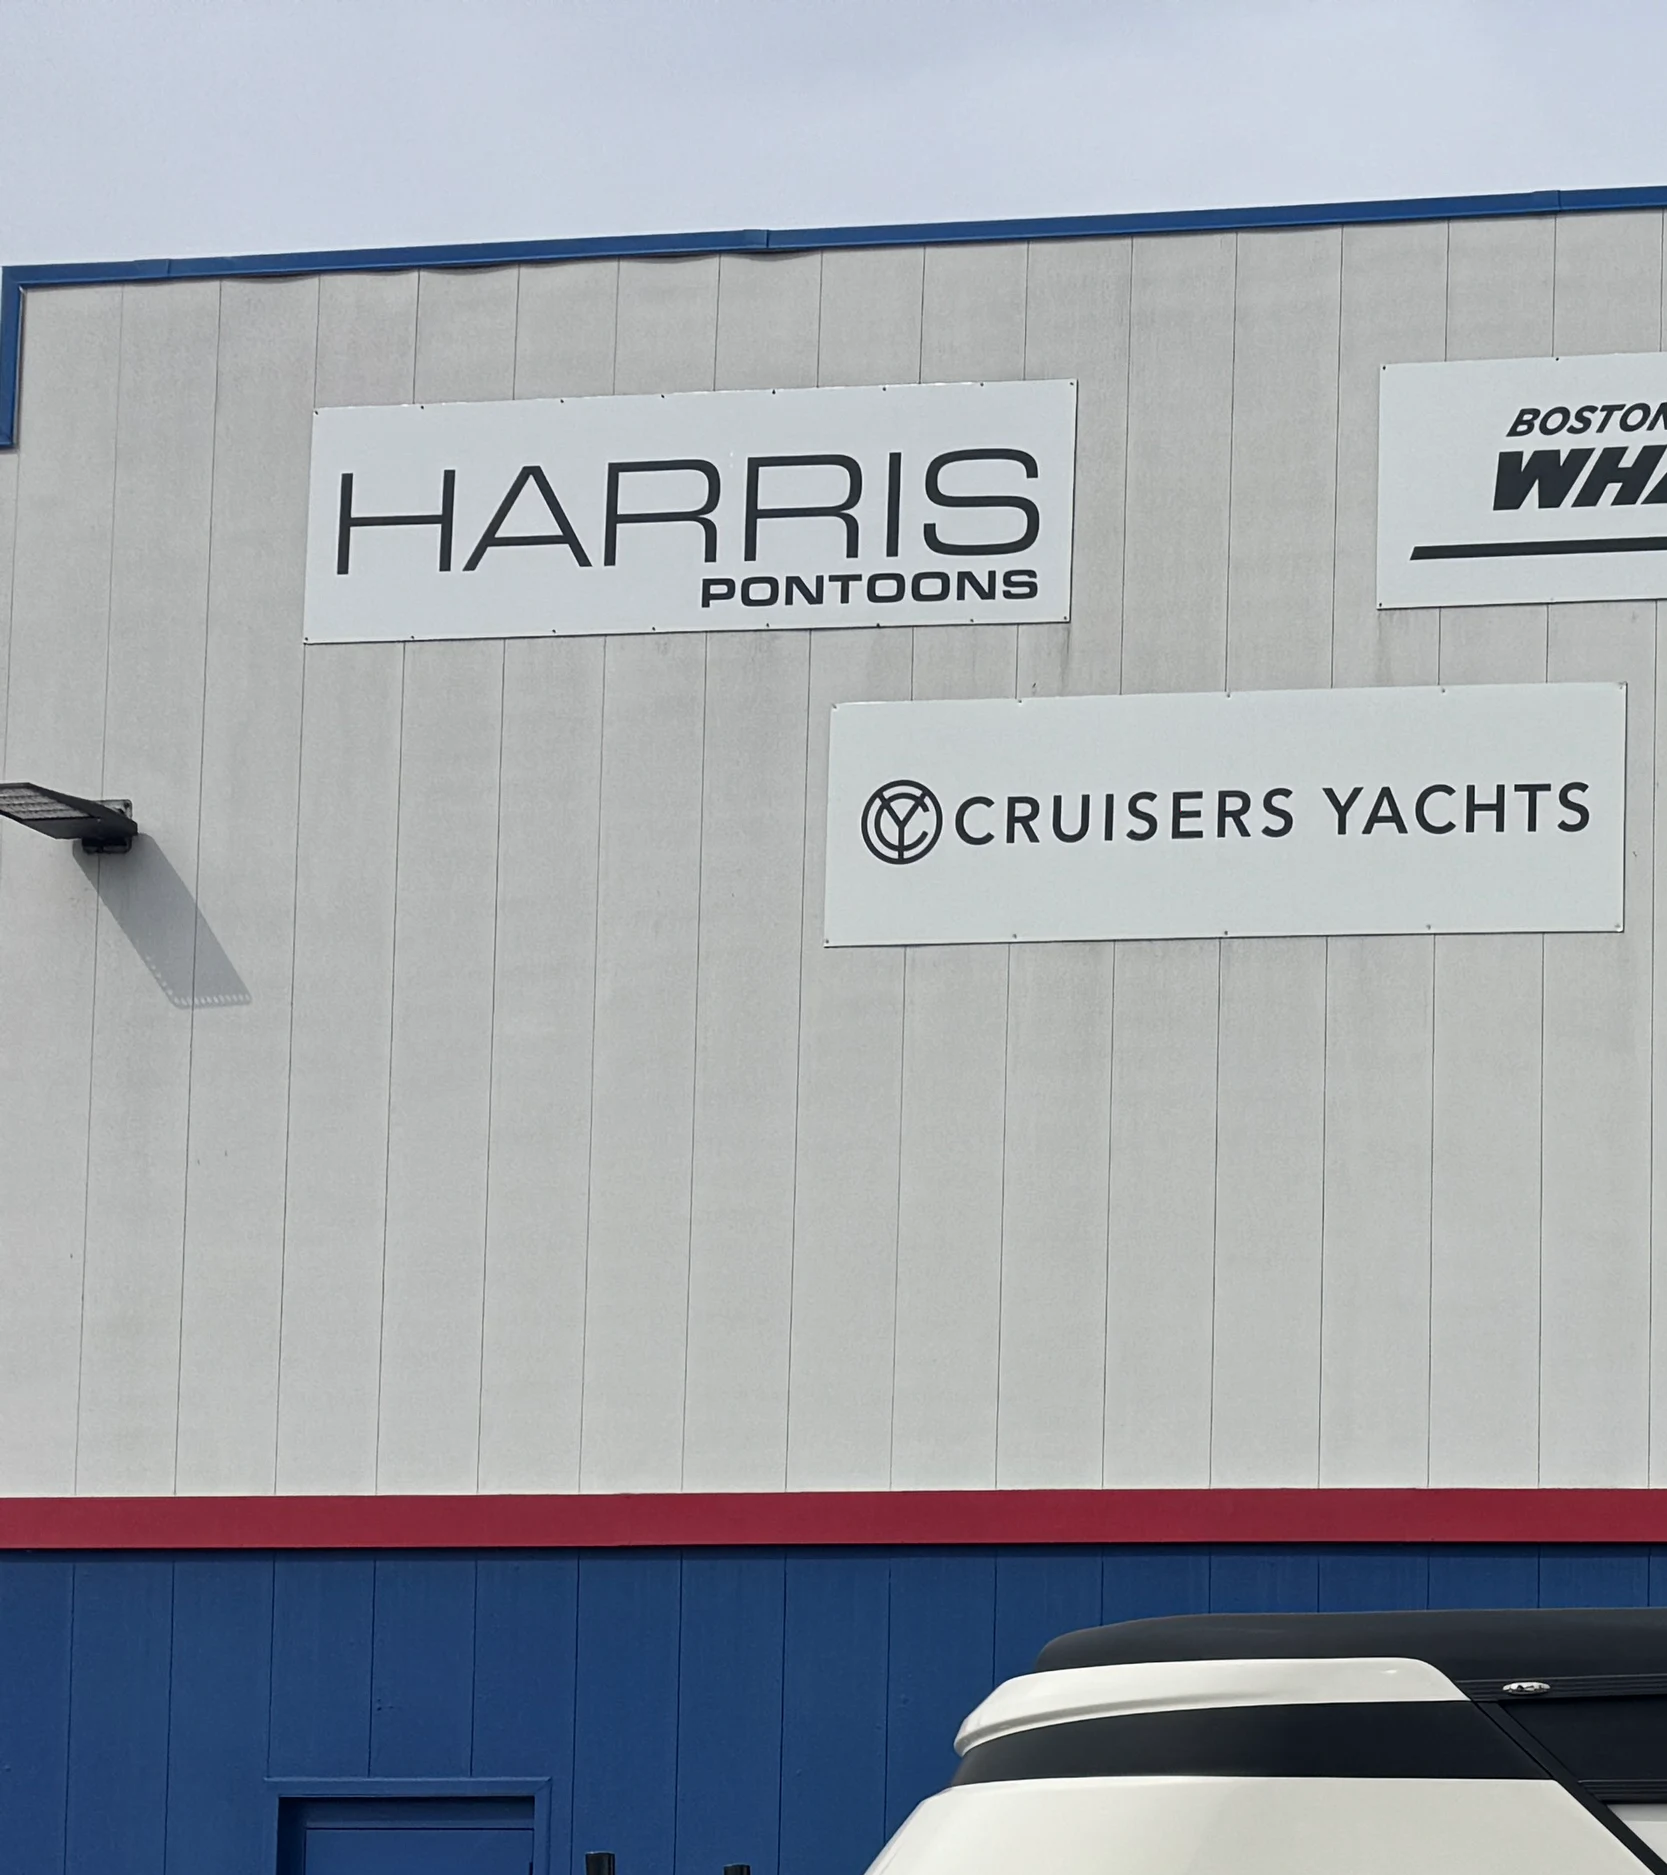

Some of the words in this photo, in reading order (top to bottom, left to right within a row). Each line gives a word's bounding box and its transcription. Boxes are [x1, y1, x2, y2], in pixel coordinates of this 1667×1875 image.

[337, 449, 1039, 574] HARRIS
[702, 570, 1037, 607] PONTOONS
[956, 788, 1293, 845] CRUISERS
[1323, 782, 1589, 834] YACHTS
